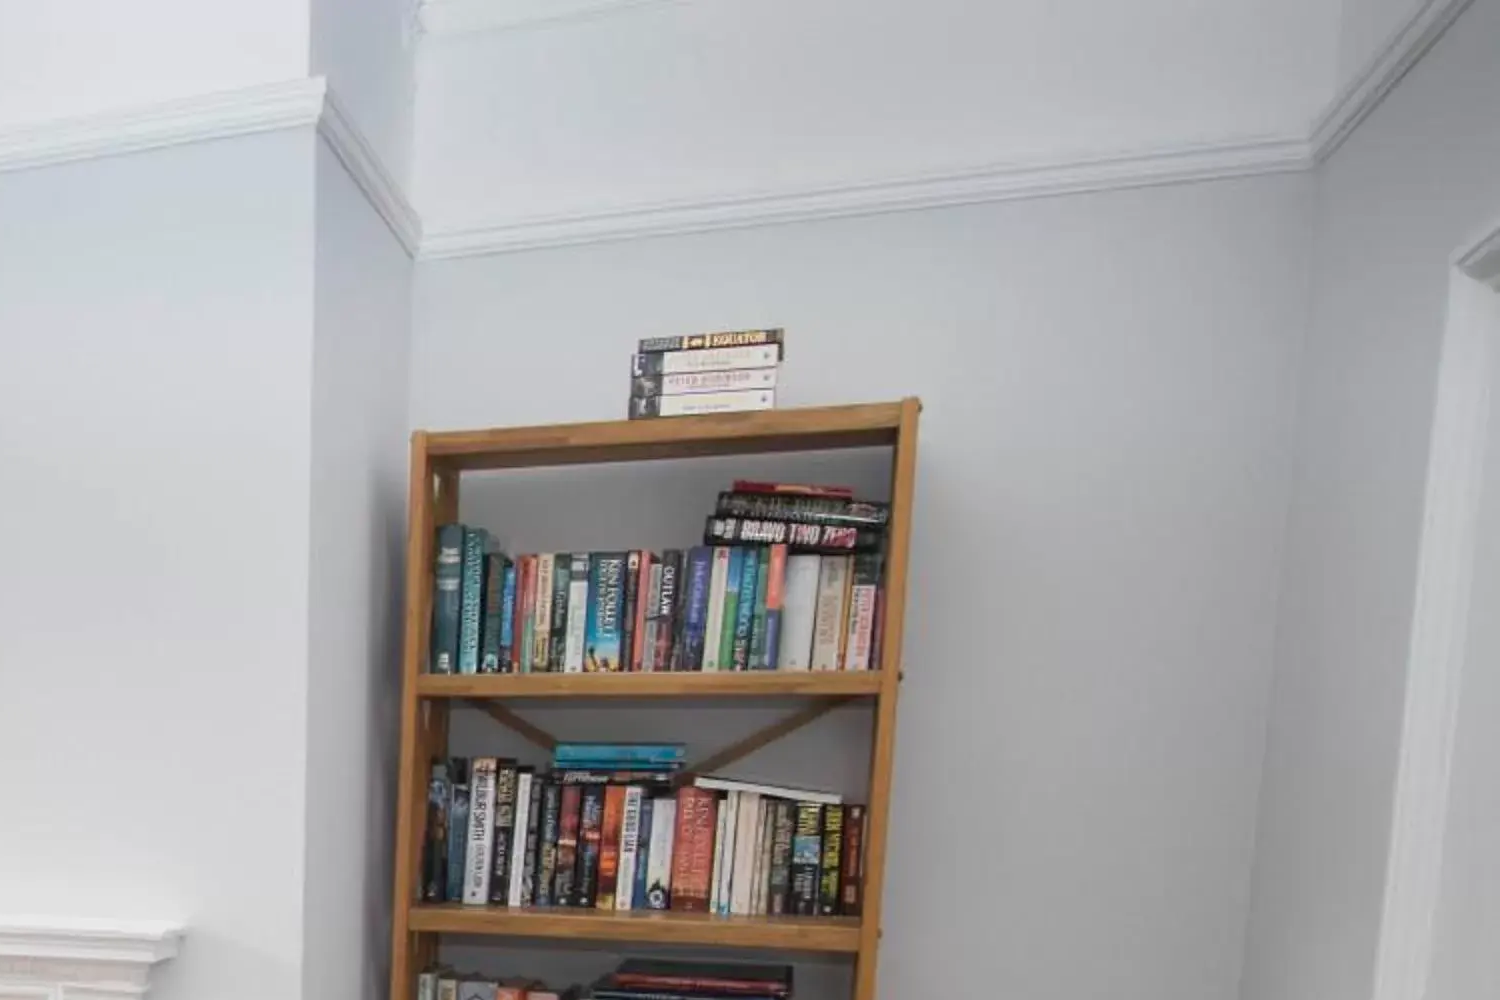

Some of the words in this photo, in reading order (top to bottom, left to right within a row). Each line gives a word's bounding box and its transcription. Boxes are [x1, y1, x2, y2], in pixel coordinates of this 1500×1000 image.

[740, 520, 786, 541] BRAVO
[789, 523, 820, 545] TWO
[820, 527, 858, 548] ZERO
[608, 559, 622, 584] KEN
[661, 566, 675, 615] OUTLAW
[602, 587, 618, 639] FOLLETT
[475, 775, 488, 810] WILBUR
[472, 812, 486, 840] SMITH
